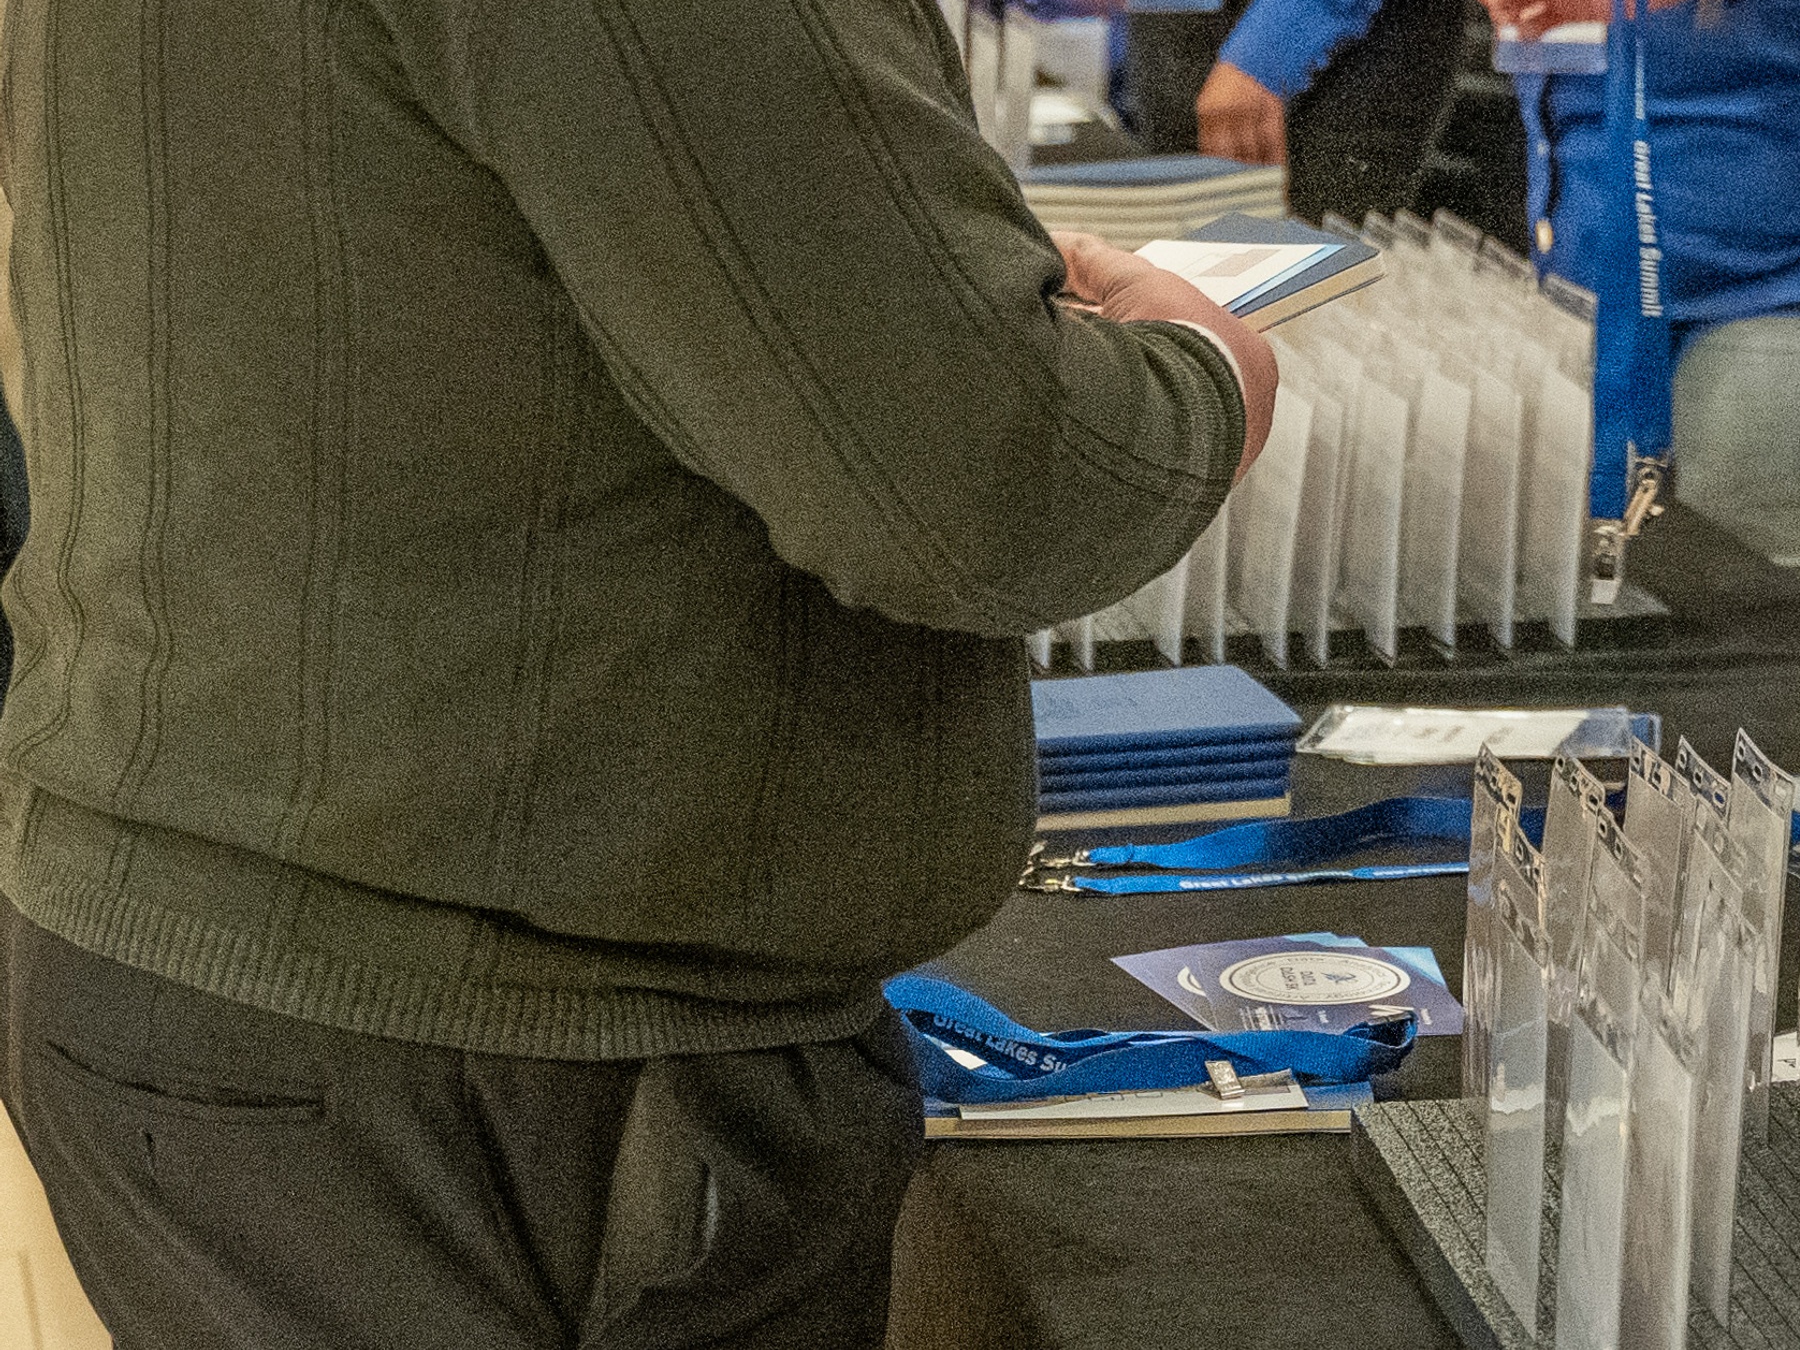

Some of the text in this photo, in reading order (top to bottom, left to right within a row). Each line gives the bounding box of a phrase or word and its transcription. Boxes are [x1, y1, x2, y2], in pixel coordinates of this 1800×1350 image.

[1633, 139, 1654, 190] Great
[1635, 191, 1659, 245] Lakes
[1639, 246, 1665, 318] Summit
[984, 1035, 1039, 1066] Lakes
